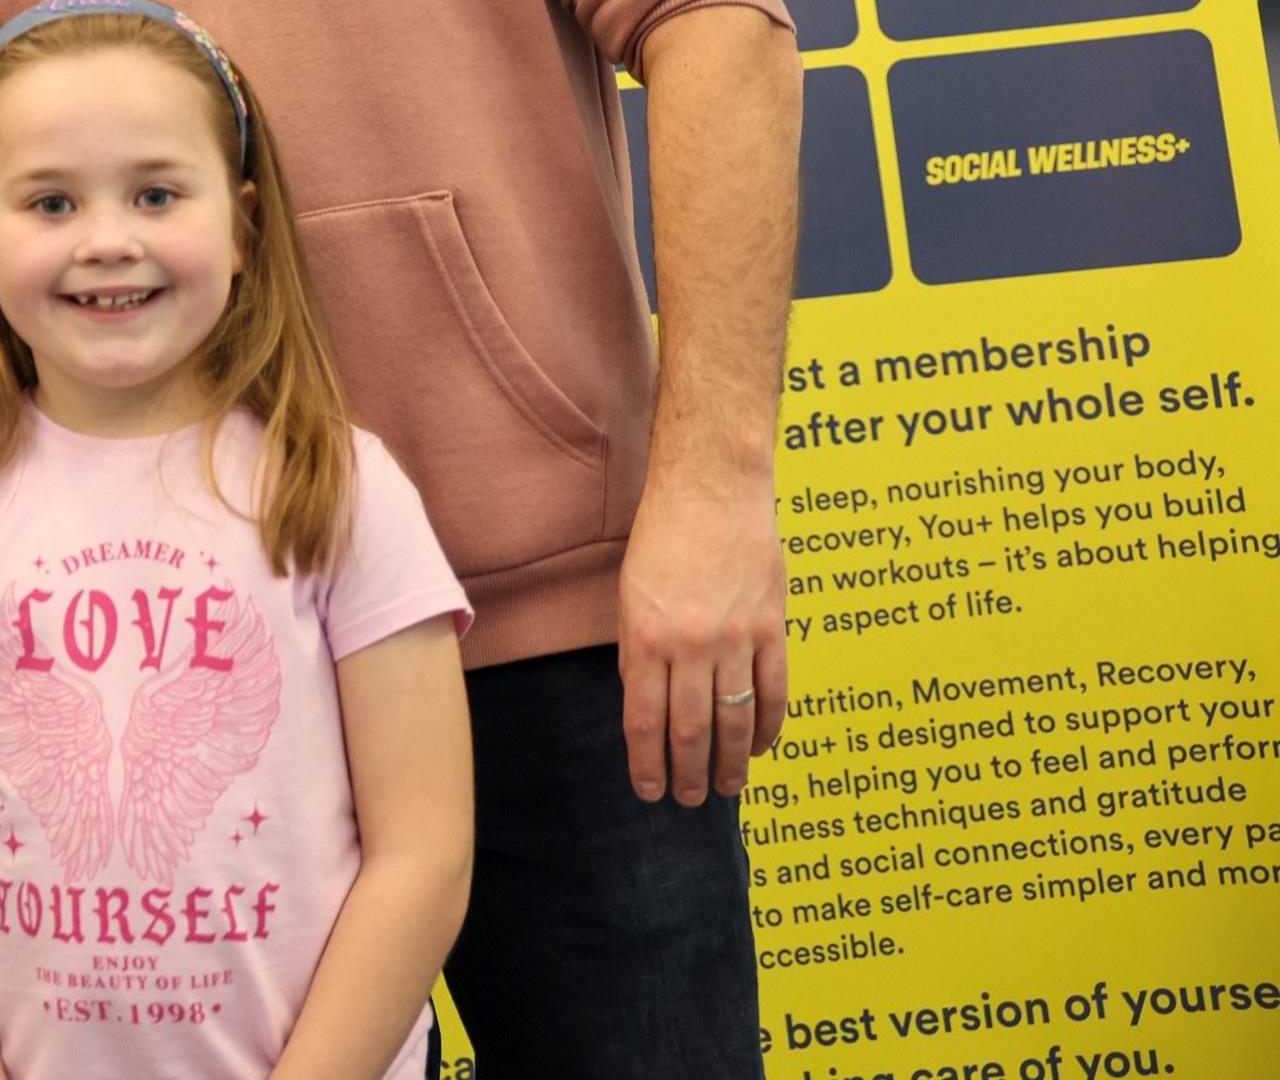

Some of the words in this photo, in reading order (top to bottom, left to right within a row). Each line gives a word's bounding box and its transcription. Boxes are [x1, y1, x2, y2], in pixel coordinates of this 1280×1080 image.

[927, 149, 1023, 184] SOCIAL
[1028, 133, 1189, 174] WELLNESS+
[839, 360, 862, 388] a
[875, 323, 1151, 383] membership
[785, 411, 885, 450] after
[897, 404, 993, 447] your
[1005, 383, 1145, 427] whole
[1159, 370, 1255, 414] self.
[792, 488, 878, 514] sleep,
[887, 468, 1045, 503] nourishing
[1055, 463, 1124, 491] your
[1134, 449, 1226, 480] body,
[920, 515, 991, 539] You+
[1003, 504, 1087, 532] helps
[1096, 502, 1152, 528] you
[1163, 488, 1247, 518] build
[61, 540, 186, 576] DREAMER
[833, 558, 970, 590] workouts
[1057, 539, 1147, 568] about
[1157, 529, 1280, 561] helping
[11, 584, 236, 673] LOVE
[823, 602, 919, 634] aspect
[928, 594, 956, 621] of
[966, 590, 1022, 616] life.
[912, 668, 1088, 703] Movement,
[1097, 659, 1256, 686] Recovery,
[847, 734, 869, 752] is
[878, 712, 1016, 749] designed
[1024, 713, 1056, 734] to
[1066, 700, 1190, 733] support
[1200, 698, 1275, 727] your
[808, 766, 918, 798] helping
[927, 764, 982, 790] you
[991, 757, 1023, 779] to
[1030, 746, 1088, 774] feel
[1099, 741, 1157, 770] and
[853, 800, 1022, 834] techniques
[1031, 787, 1088, 817] and
[1096, 777, 1248, 817] gratitude
[777, 855, 831, 885] and
[840, 844, 924, 877] social
[934, 832, 1135, 868] connections,
[1143, 825, 1233, 850] every
[754, 908, 784, 927] to
[793, 894, 872, 923] make
[880, 884, 1013, 914] self-care
[1022, 869, 1136, 902] simpler
[1147, 861, 1208, 891] and
[93, 955, 160, 972] ENJOY
[760, 932, 905, 968] ccessible.
[36, 967, 62, 985] THE
[68, 974, 148, 989] BEAUTY
[156, 976, 182, 990] OF
[191, 970, 234, 989] LIFE
[785, 1008, 878, 1049] best
[888, 991, 1051, 1038] version
[1064, 980, 1108, 1022] of
[1020, 1044, 1062, 1080] of
